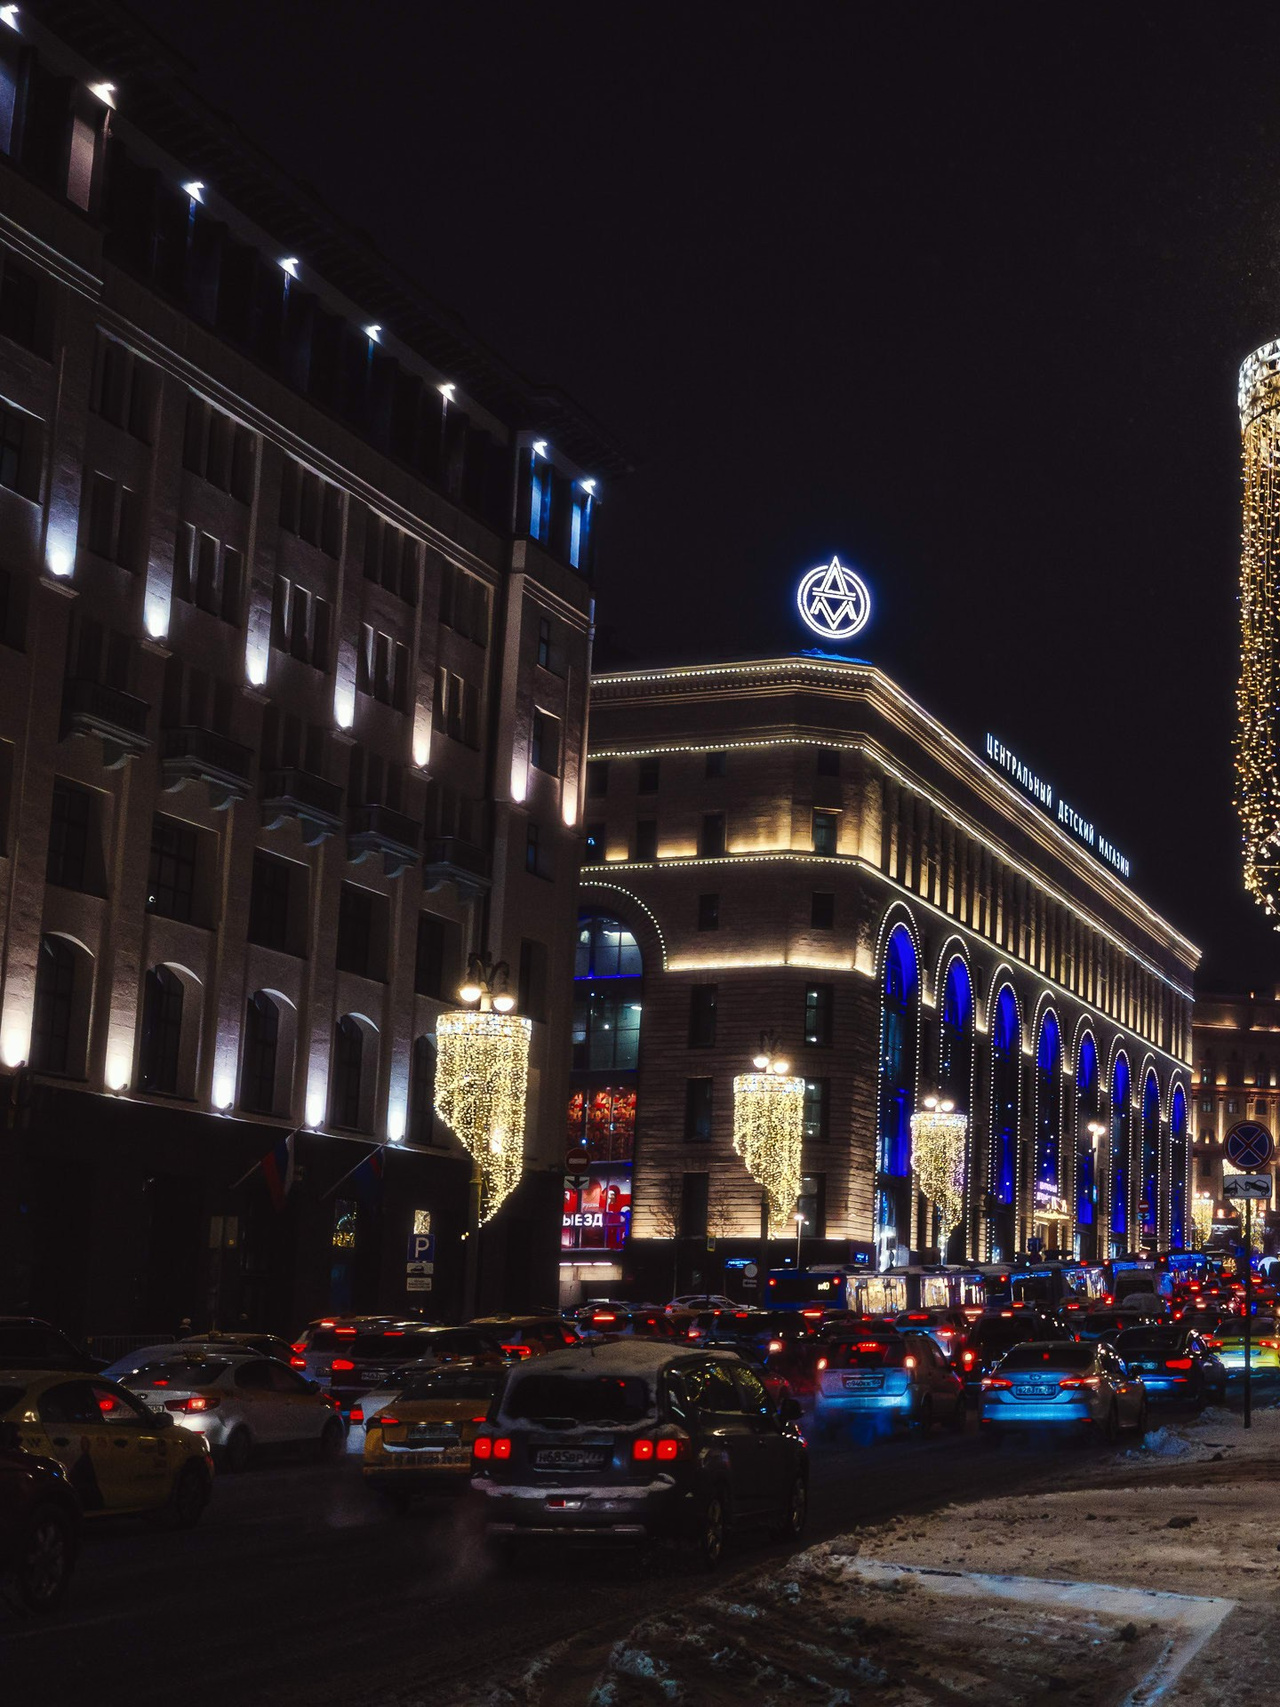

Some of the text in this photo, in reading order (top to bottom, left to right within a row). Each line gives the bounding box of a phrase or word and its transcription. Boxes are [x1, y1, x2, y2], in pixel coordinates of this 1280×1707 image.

[986, 732, 1131, 878] ЦЕНТРАЛЬНЫЙ ДЕТСКИЙ МАГАЗИН
[414, 1237, 430, 1258] P
